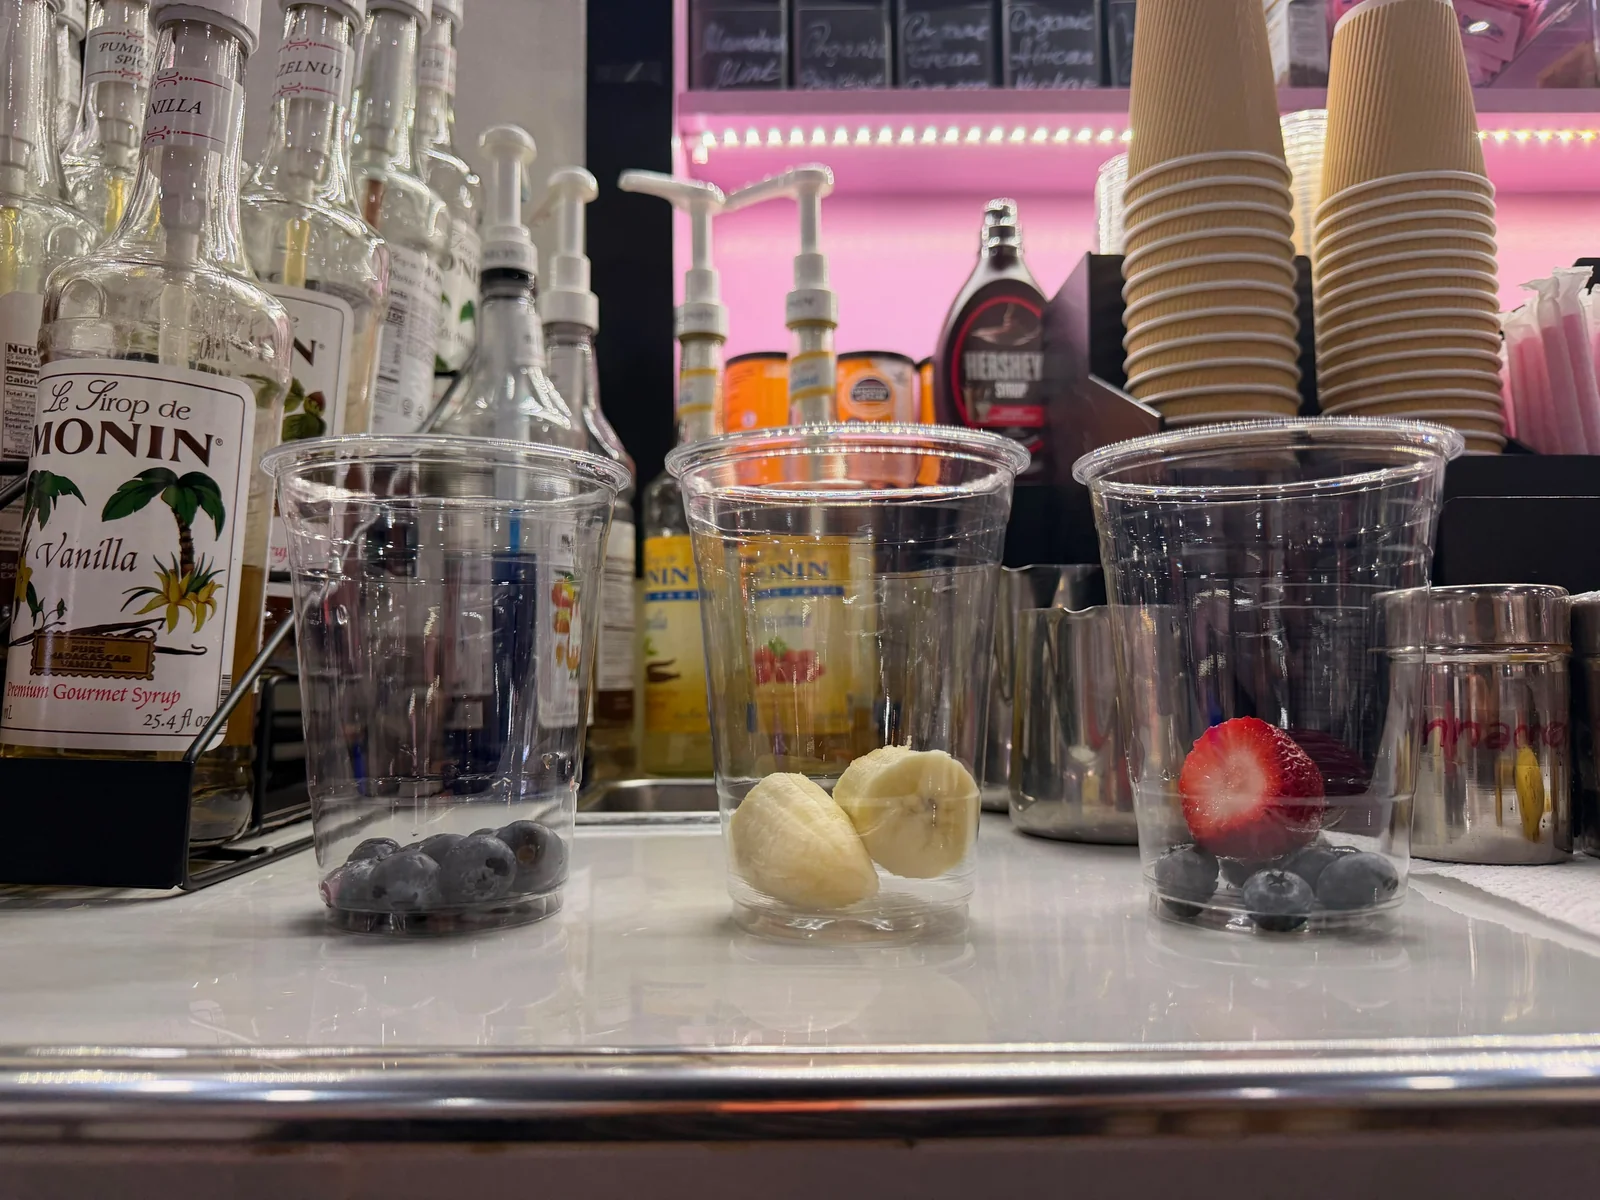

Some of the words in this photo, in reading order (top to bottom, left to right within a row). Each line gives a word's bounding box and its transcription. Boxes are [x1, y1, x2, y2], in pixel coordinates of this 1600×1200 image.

[146, 98, 202, 119] NILLA
[43, 381, 74, 413] Le
[76, 380, 149, 422] Sirop
[158, 400, 191, 420] de
[31, 418, 214, 467] MONIN
[35, 533, 137, 572] Vanilla
[7, 681, 49, 699] Premium
[53, 683, 128, 702] Gourmet
[131, 687, 181, 711] Syrup
[143, 713, 176, 729] 25.4
[175, 708, 193, 733] fl
